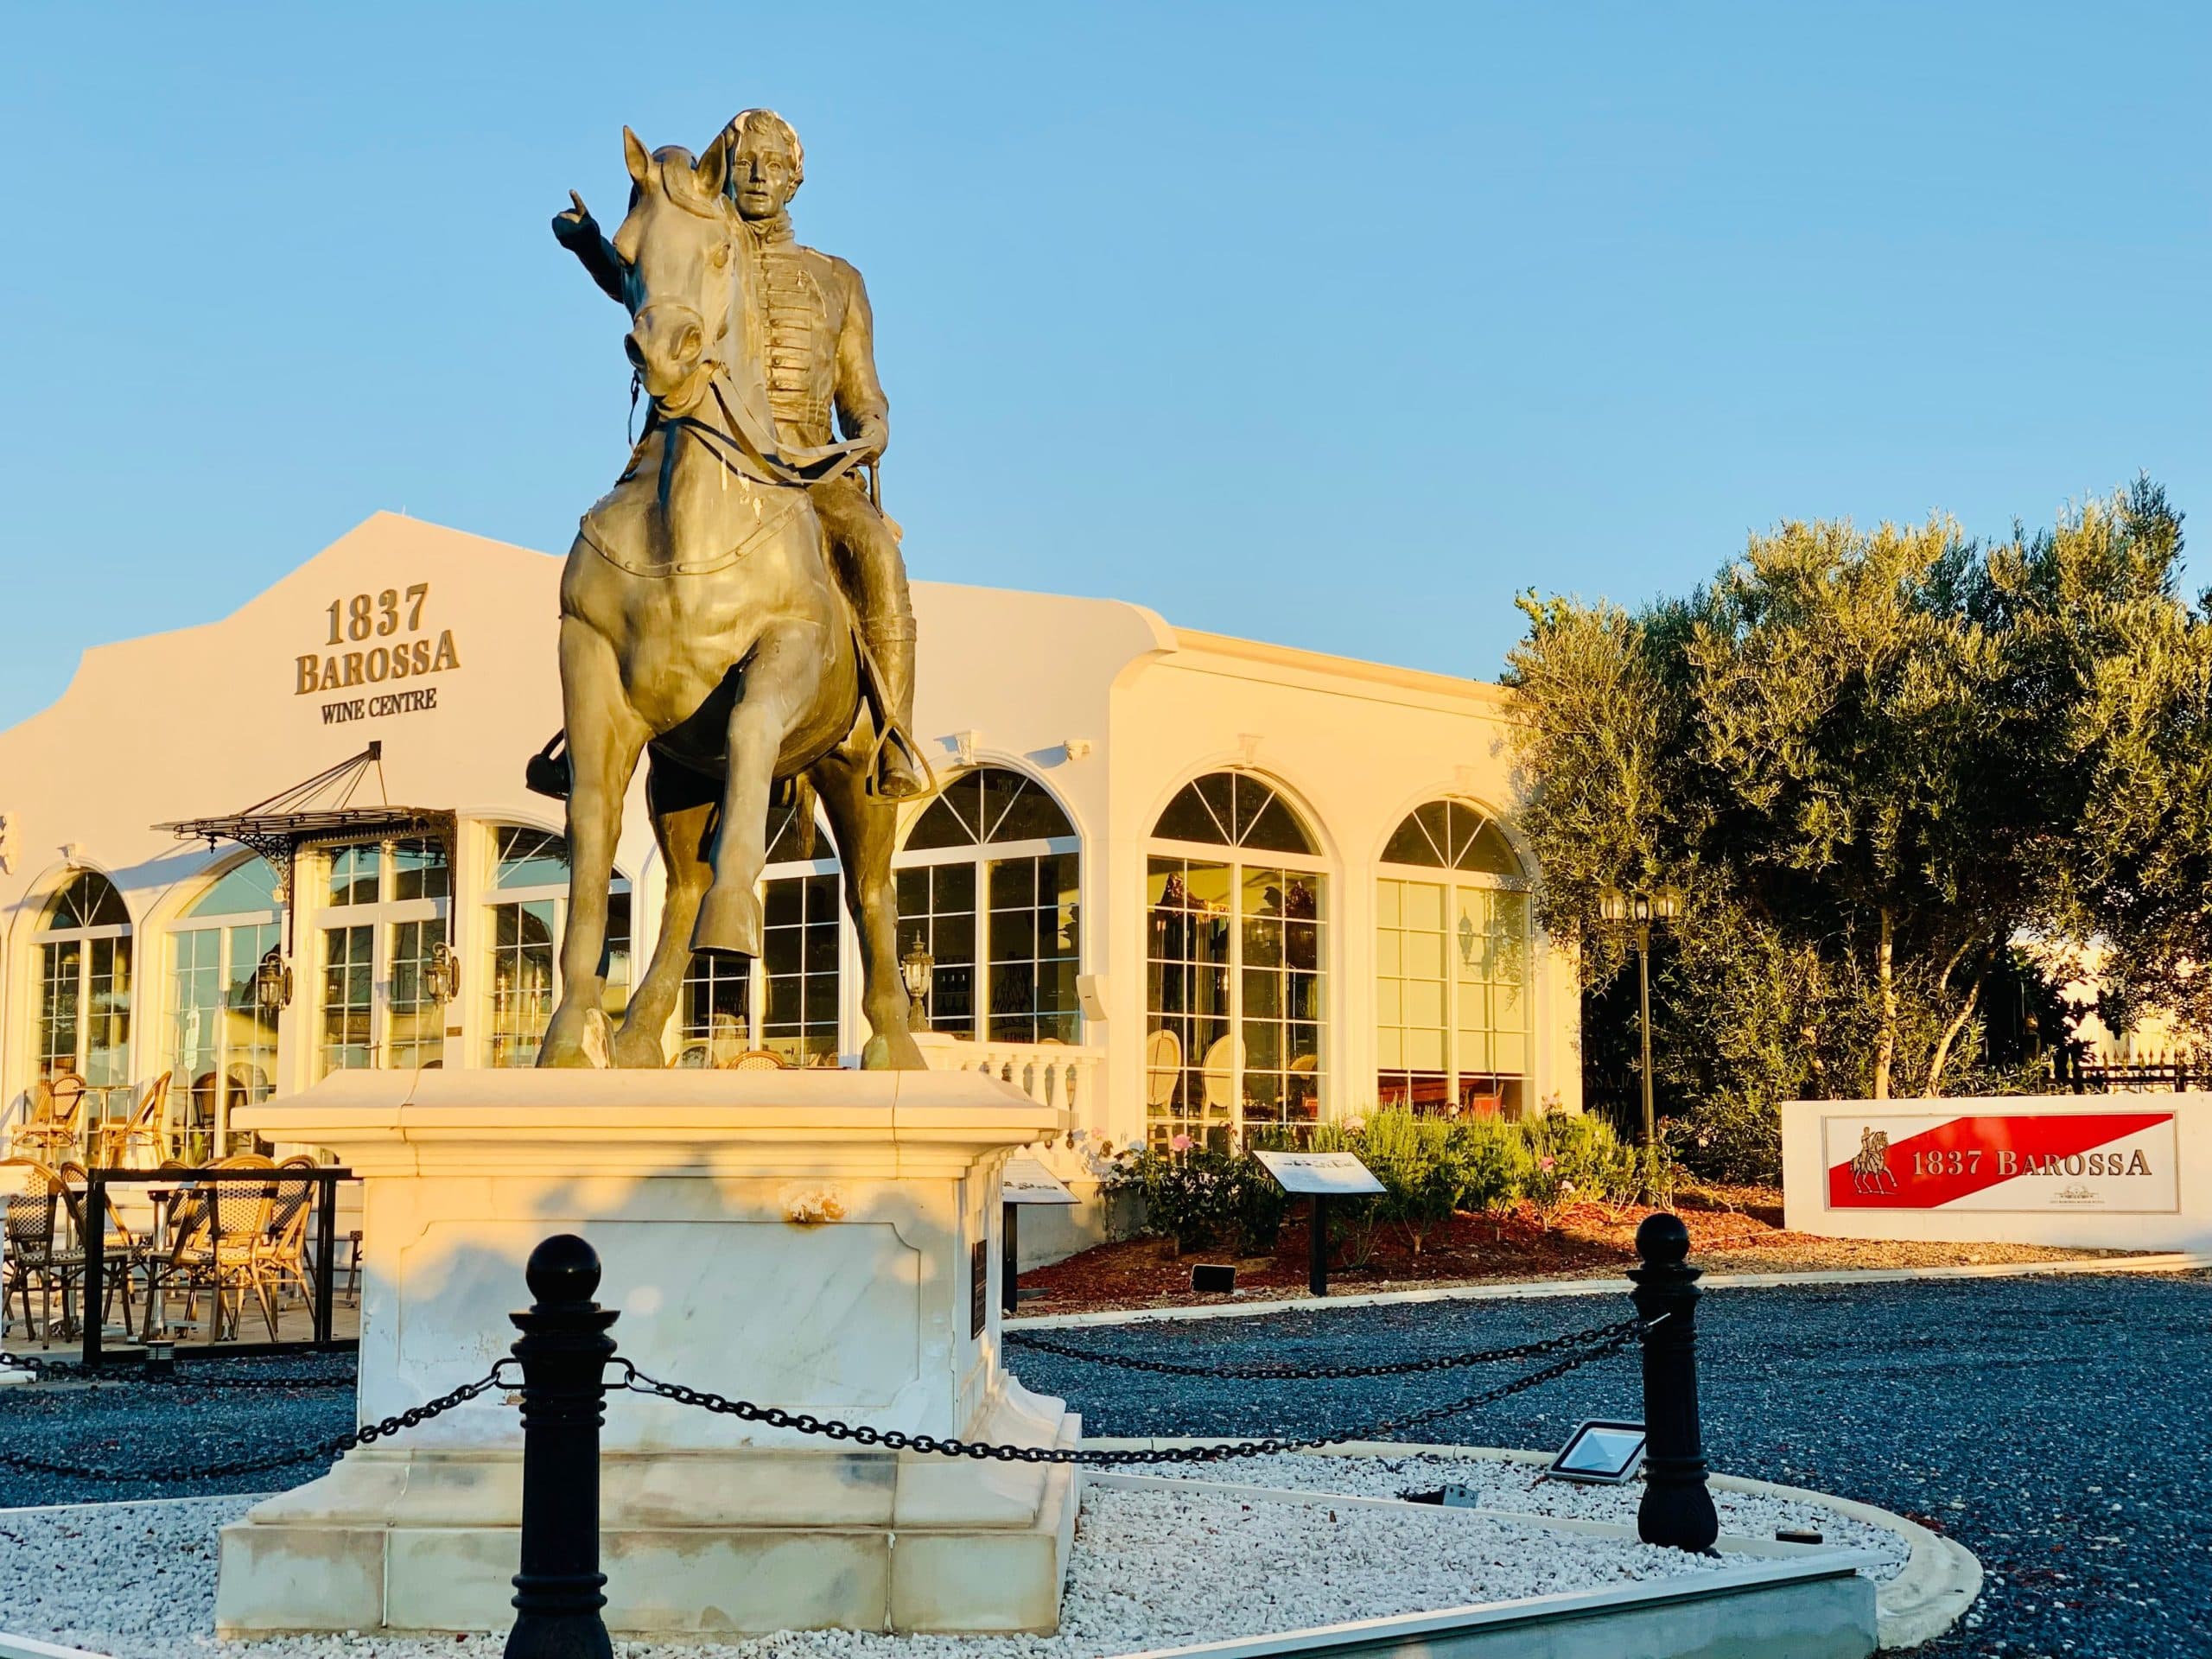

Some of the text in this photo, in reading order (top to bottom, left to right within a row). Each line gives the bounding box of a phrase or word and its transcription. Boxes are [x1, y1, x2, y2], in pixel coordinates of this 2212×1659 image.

[326, 582, 429, 645] 1837
[295, 629, 460, 695] BAROSSA
[321, 688, 436, 725] WINE CENTRE
[1913, 1149, 2152, 1176] 1837 BAROSSA
